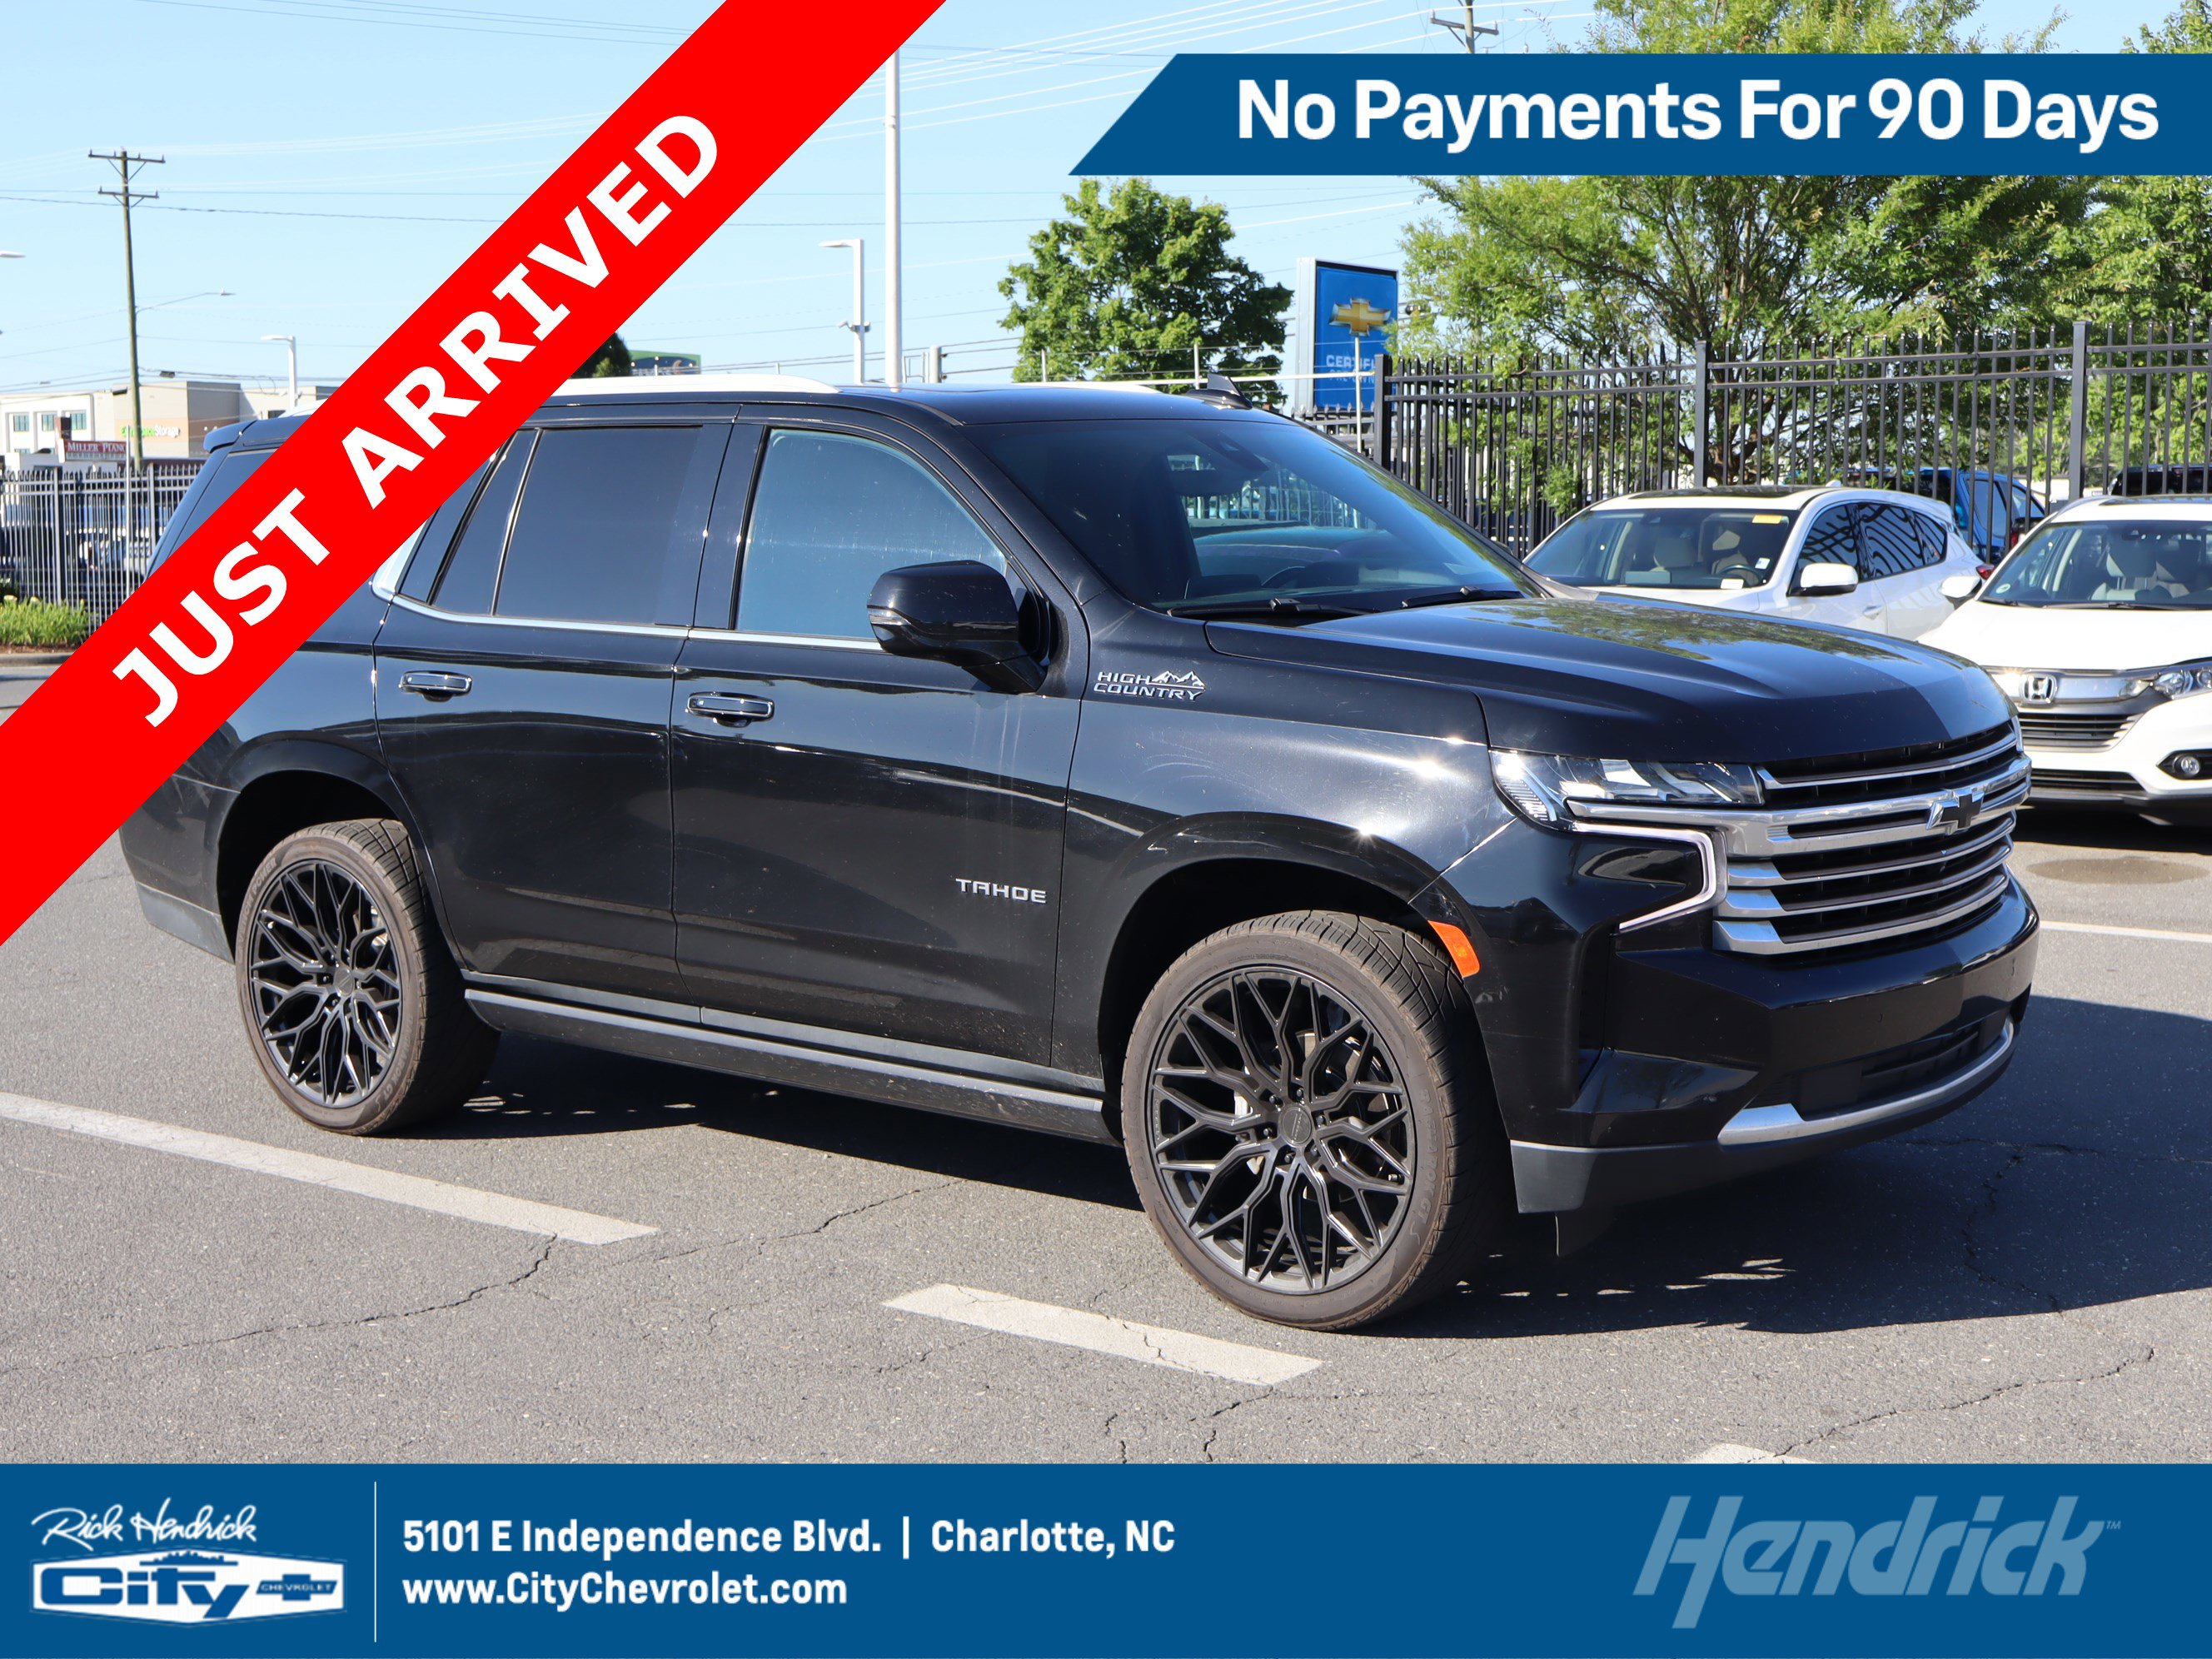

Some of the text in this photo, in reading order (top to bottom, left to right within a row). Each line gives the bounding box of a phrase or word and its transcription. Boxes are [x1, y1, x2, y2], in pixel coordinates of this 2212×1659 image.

[1098, 671, 1151, 685] HIGH
[1094, 683, 1203, 701] COUNTRY
[955, 878, 1046, 904] TAHOE
